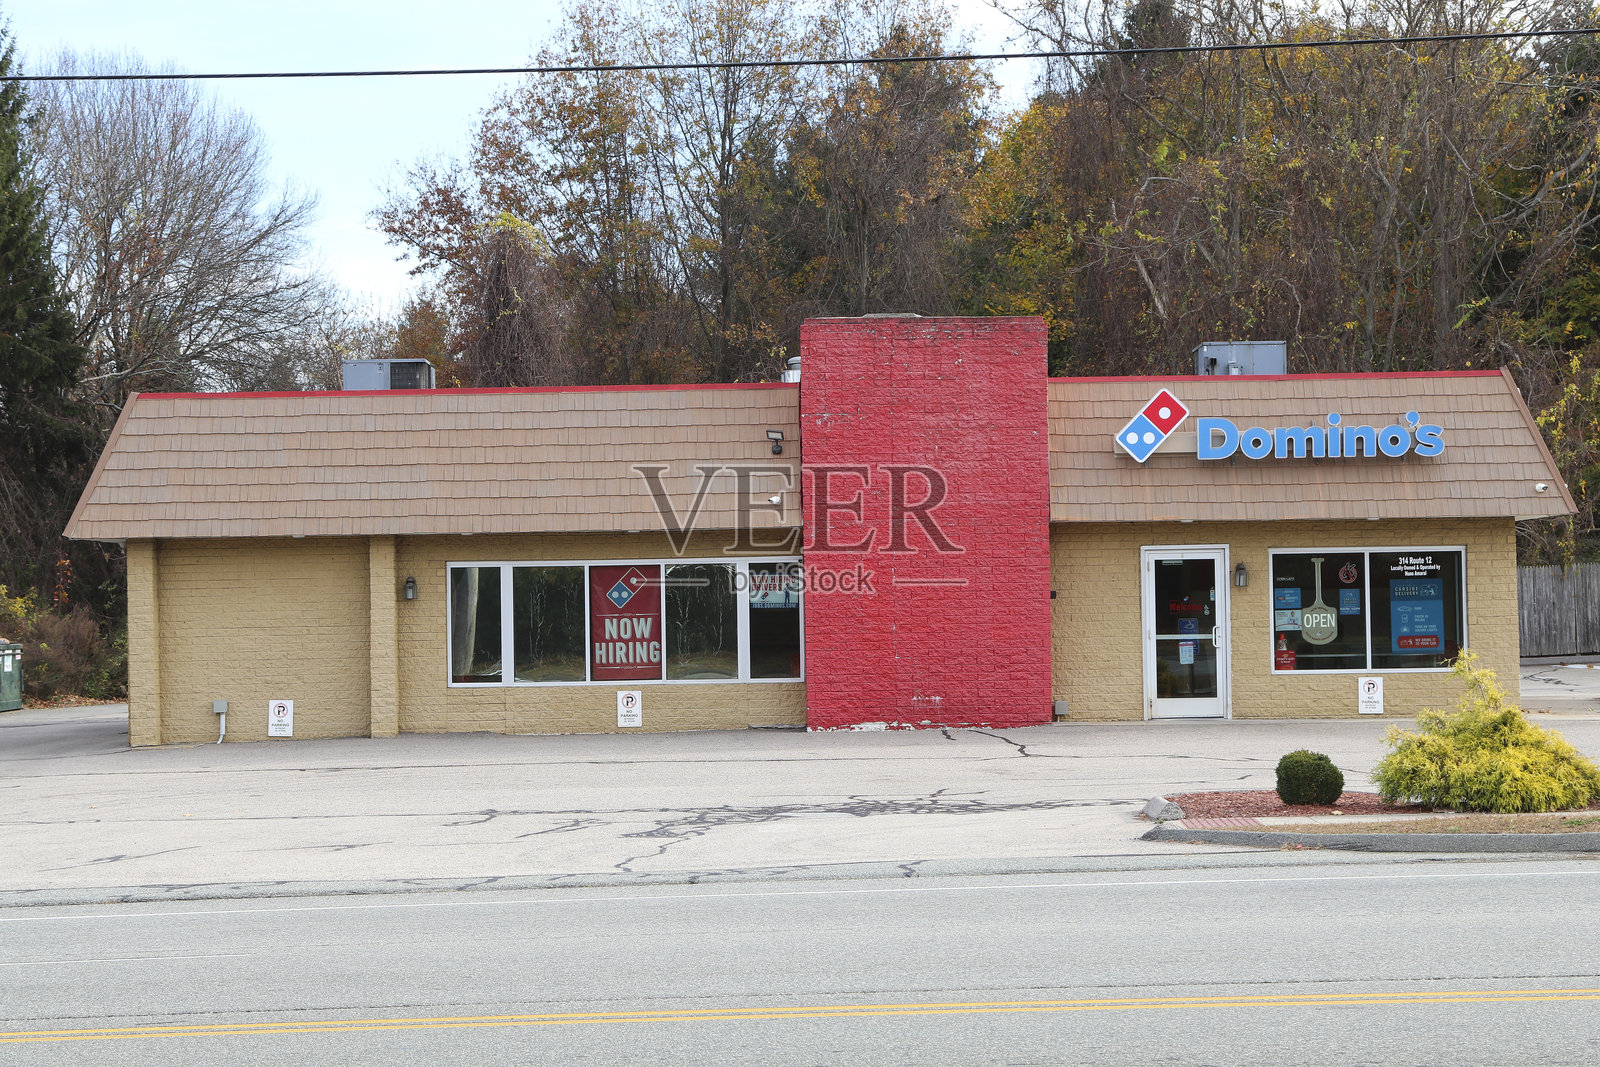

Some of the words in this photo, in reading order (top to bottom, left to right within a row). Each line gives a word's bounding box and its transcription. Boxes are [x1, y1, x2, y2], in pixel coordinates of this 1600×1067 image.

[1197, 411, 1445, 460] Domino's
[1426, 556, 1432, 564] 12
[751, 575, 769, 584] NOW
[771, 575, 796, 584] HIRING
[751, 583, 783, 592] DRIVERS
[1304, 613, 1335, 628] OPEN
[604, 617, 653, 640] NOW
[595, 640, 661, 664] HIRING
